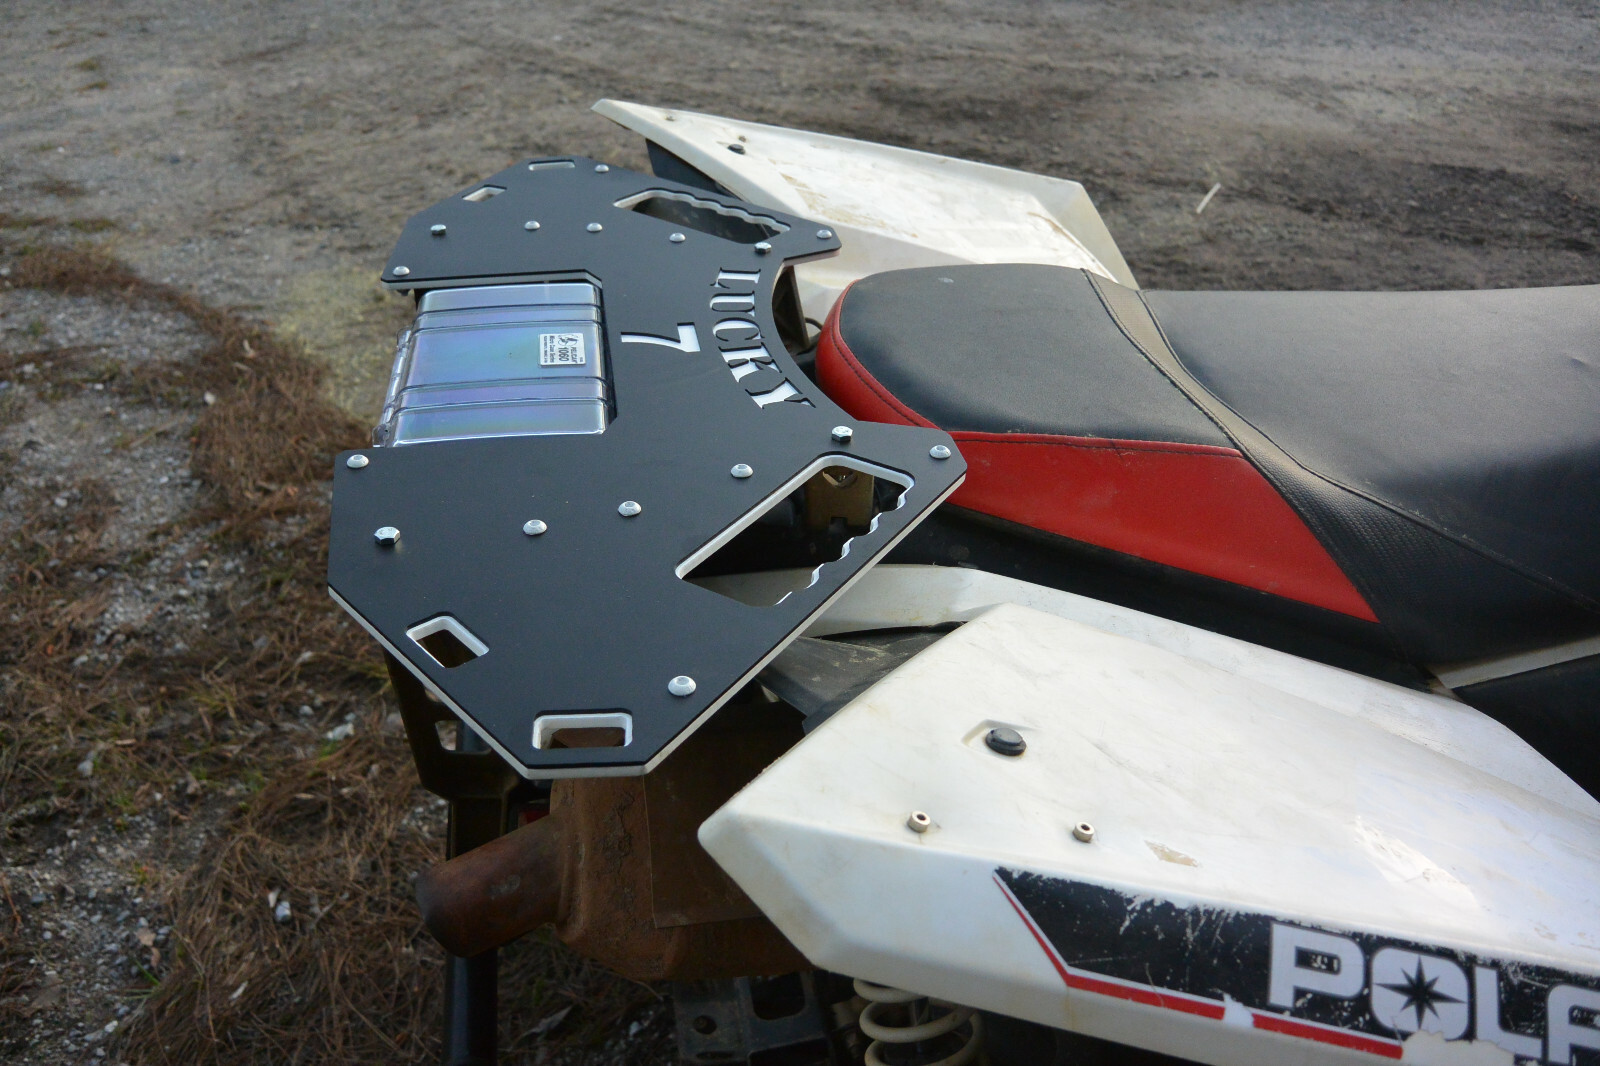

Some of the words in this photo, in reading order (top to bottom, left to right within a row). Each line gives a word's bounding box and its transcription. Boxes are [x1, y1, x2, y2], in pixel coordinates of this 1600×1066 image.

[620, 322, 700, 353] 7
[709, 267, 816, 409] LUCKY
[558, 347, 569, 361] 1060
